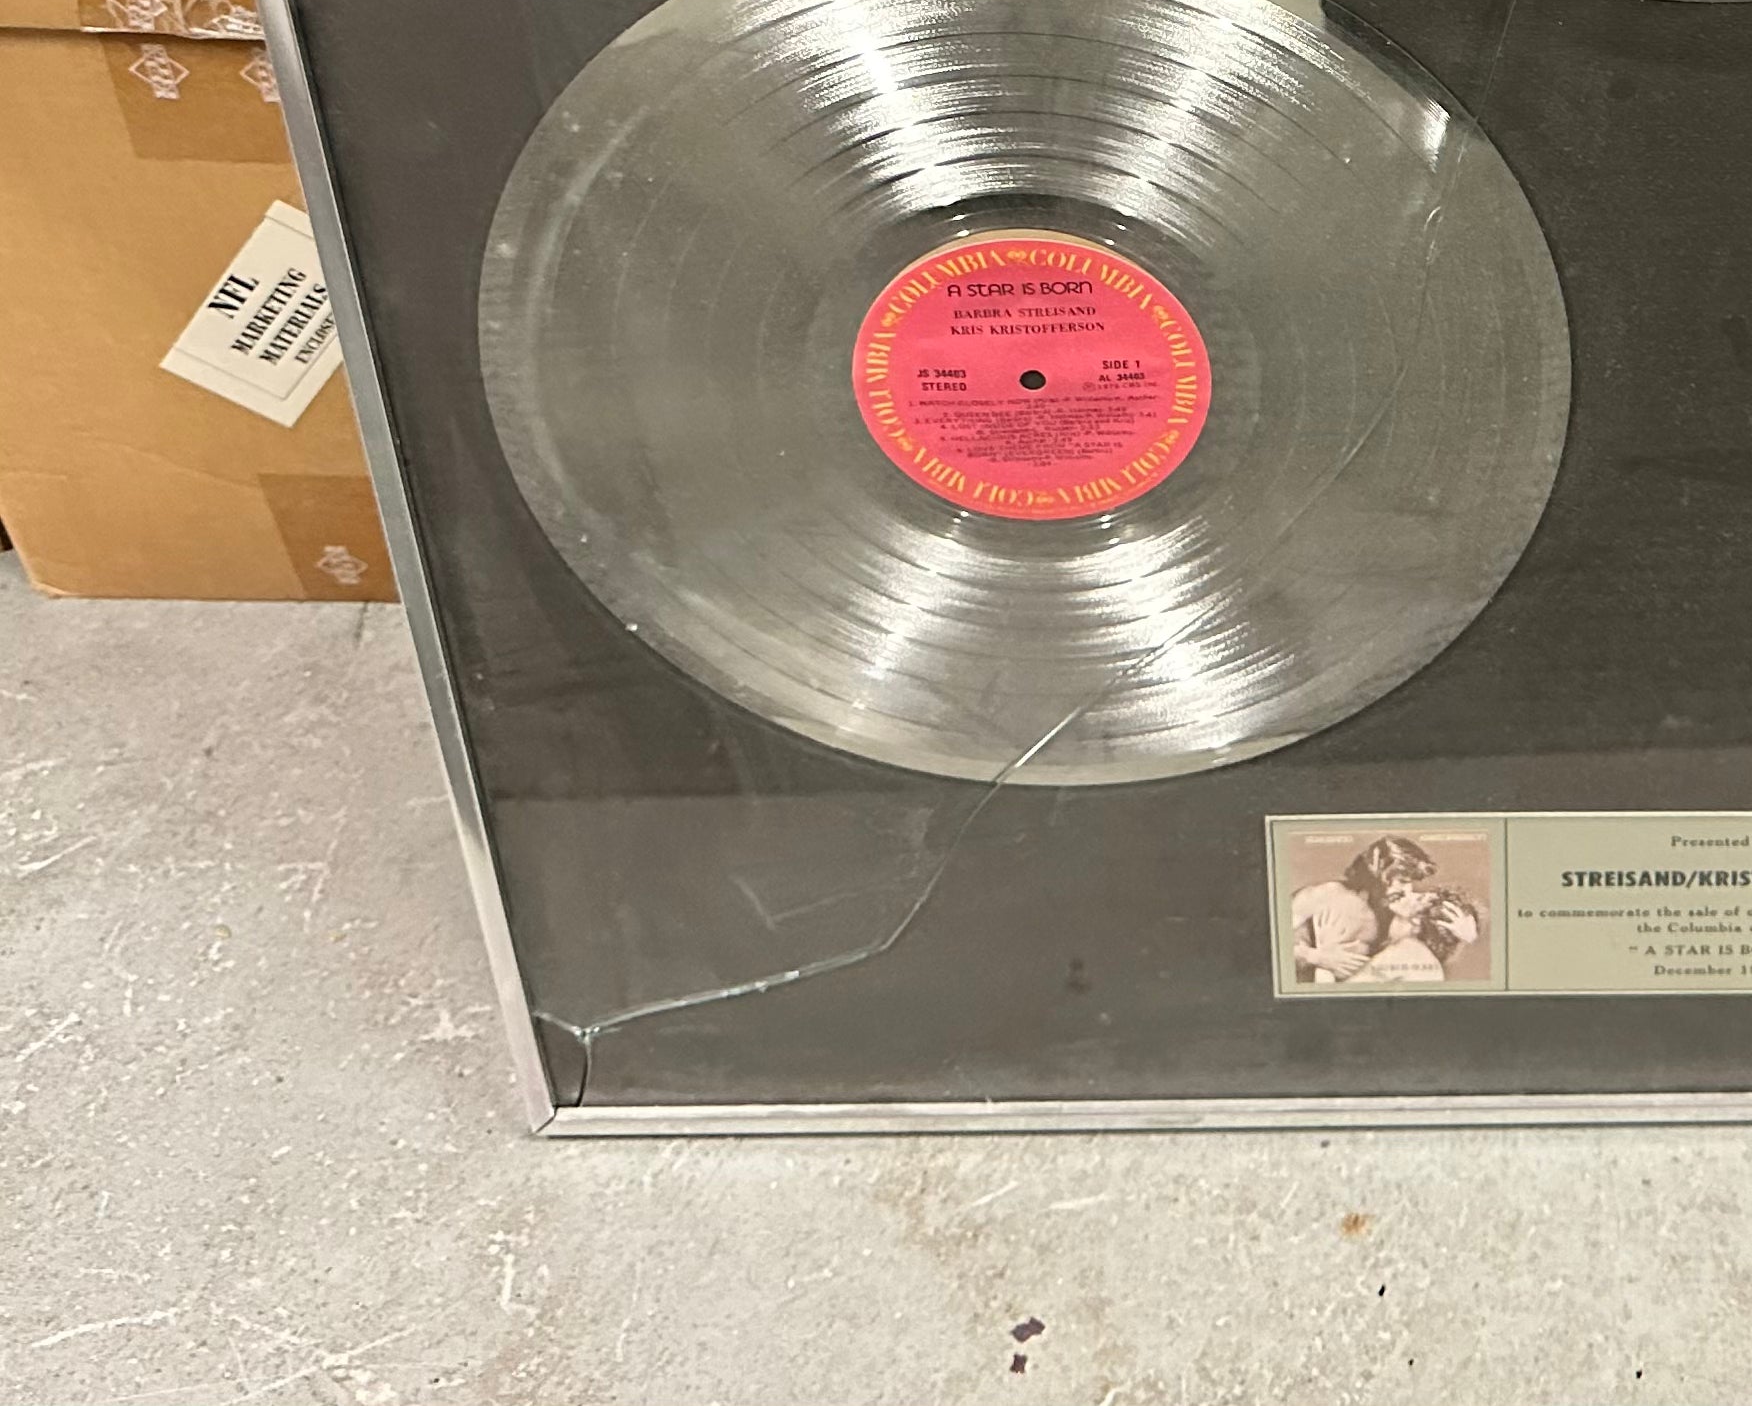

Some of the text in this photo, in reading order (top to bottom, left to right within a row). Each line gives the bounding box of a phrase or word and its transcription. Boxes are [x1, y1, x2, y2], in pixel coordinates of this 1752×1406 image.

[889, 249, 1006, 315] COLUMBIA
[1027, 248, 1152, 309] COLUMBIA
[207, 273, 260, 320] NFL
[946, 281, 1094, 297] A STAR IS BORN
[230, 266, 308, 356] MARKETING
[953, 306, 1097, 320] BARBRA STREISAND
[258, 282, 329, 367] MATERIALS
[950, 321, 1106, 336] KRIS KRISTOFFERSON
[1102, 359, 1141, 370] SIDE 1
[1161, 319, 1197, 424] COLUMBIA
[1098, 374, 1111, 382] AL
[865, 332, 906, 442] COLUMBIA
[921, 382, 967, 392] STEREO
[1670, 834, 1750, 849] Presented
[1517, 907, 1534, 919] to
[1539, 907, 1651, 919] commemorate
[1656, 905, 1683, 918] the
[1688, 905, 1719, 918] sale
[1724, 905, 1741, 918] of
[1636, 921, 1662, 934] the
[1667, 921, 1743, 934] Columbia
[1644, 944, 1657, 956] A
[1664, 943, 1711, 956] STAR
[1718, 943, 1735, 956] IS
[1653, 964, 1733, 976] December
